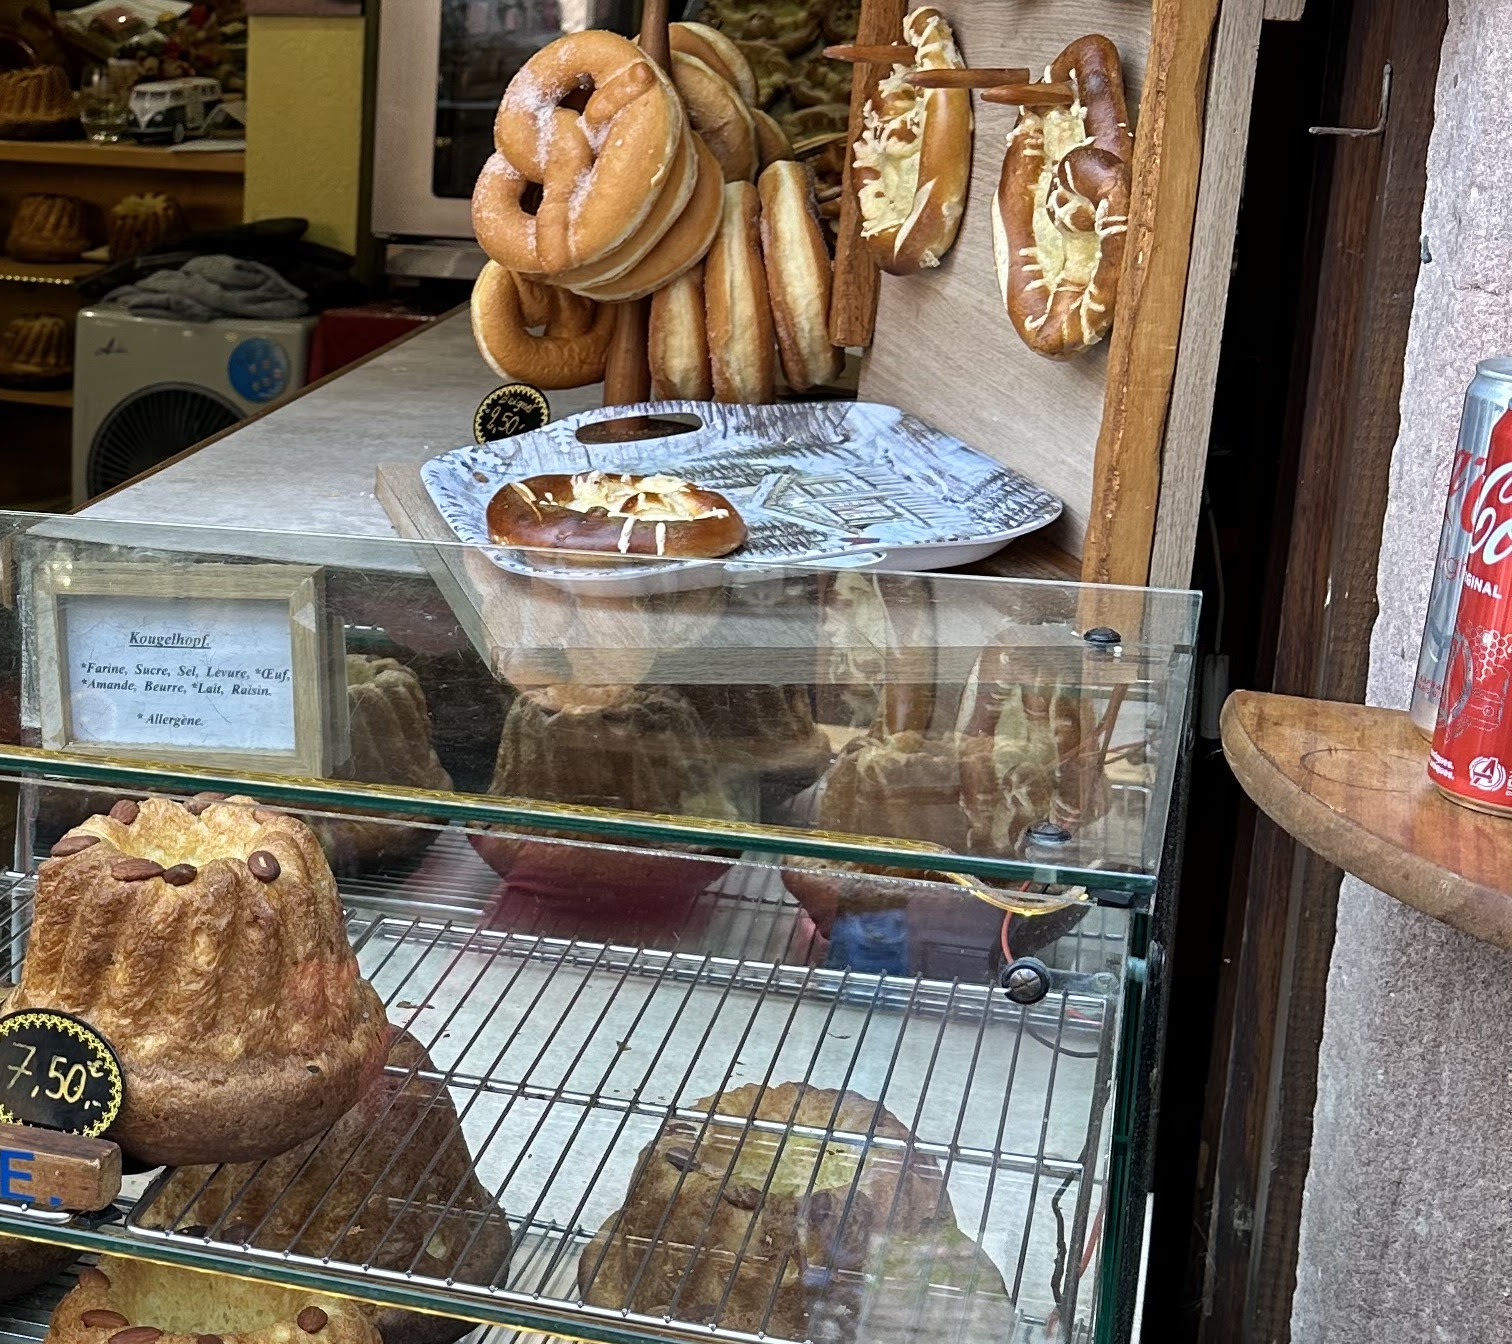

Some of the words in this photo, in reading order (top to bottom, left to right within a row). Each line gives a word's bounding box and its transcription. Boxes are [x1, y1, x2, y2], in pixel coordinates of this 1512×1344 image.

[134, 663, 171, 677] Sucre,
[176, 665, 199, 679] Sel,
[144, 680, 187, 695] Beurre,
